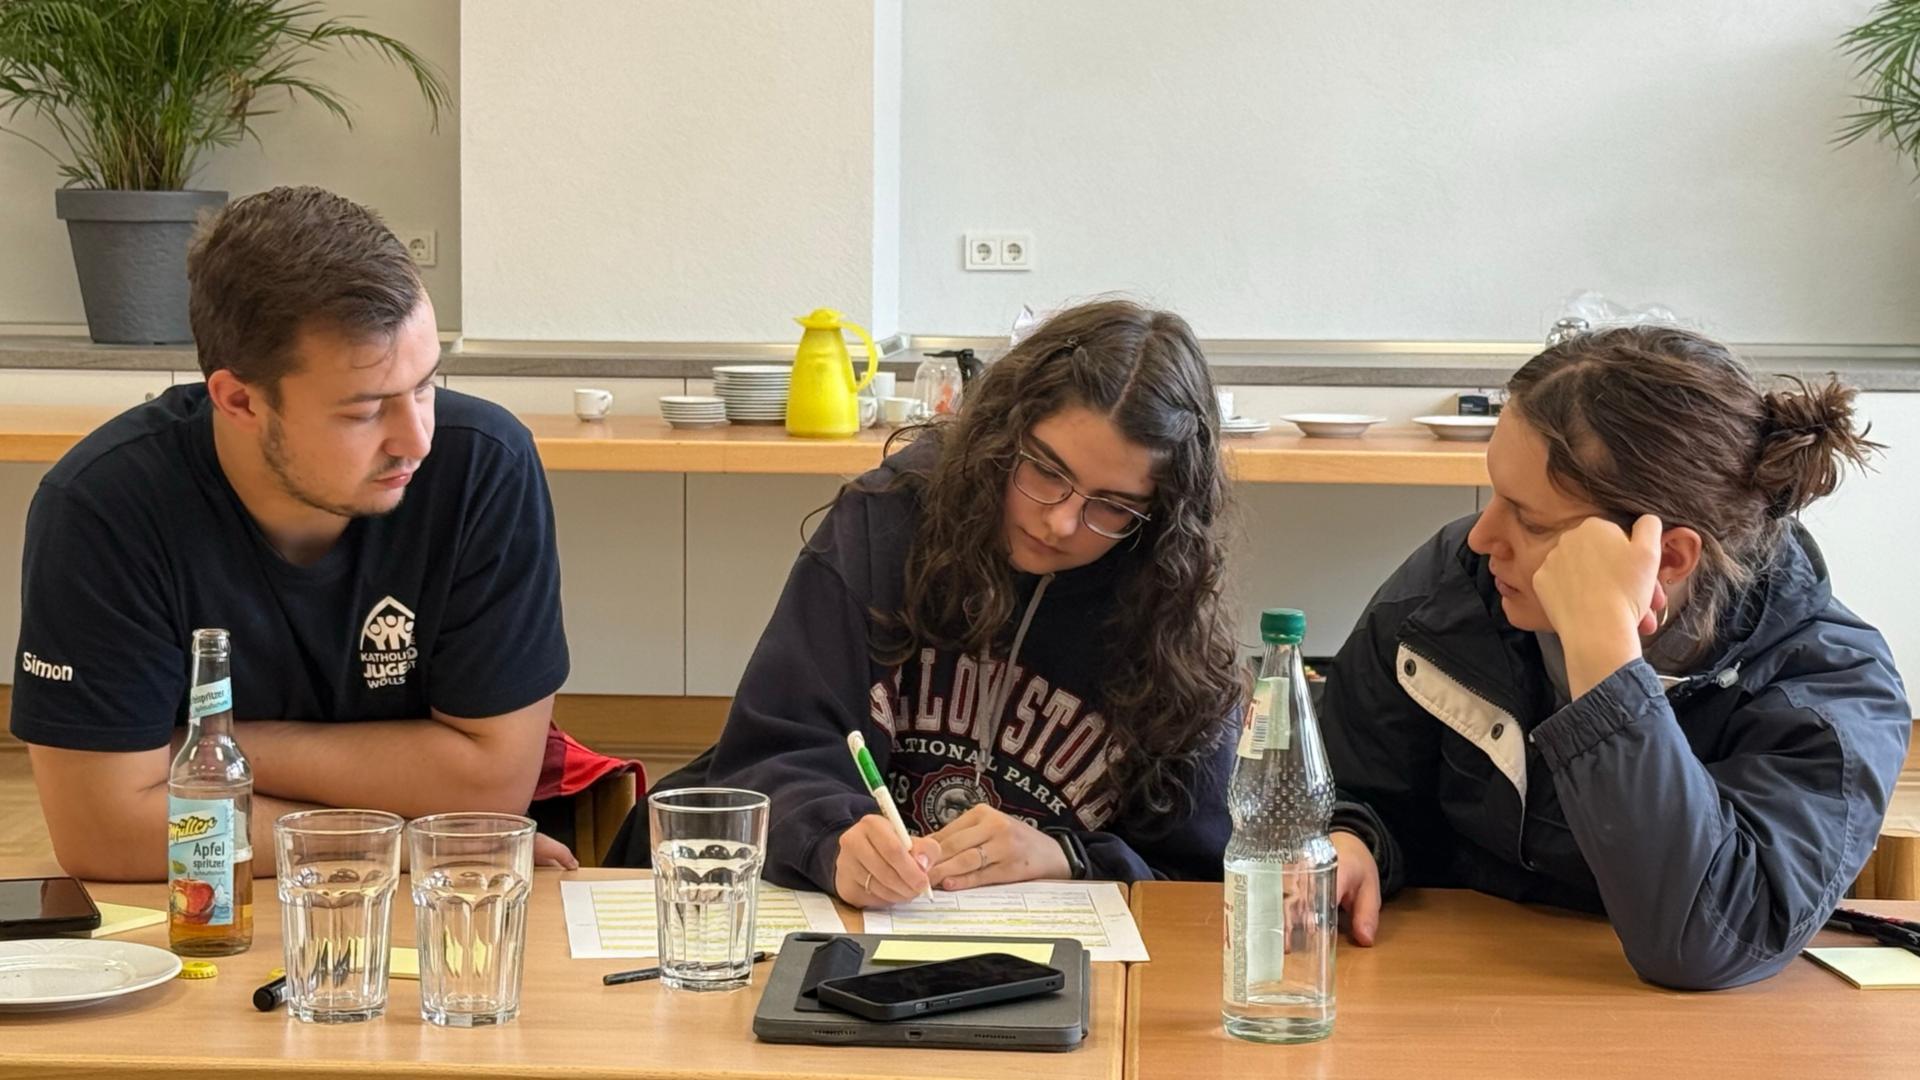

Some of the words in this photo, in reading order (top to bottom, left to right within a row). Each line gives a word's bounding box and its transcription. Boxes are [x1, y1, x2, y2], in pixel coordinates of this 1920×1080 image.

[360, 651, 407, 662] KATHOLI
[23, 651, 73, 681] Simon
[363, 661, 410, 678] JUGE
[1003, 765, 1068, 817] PARK
[193, 841, 225, 859] Apfel
[193, 859, 225, 870] spritzer
